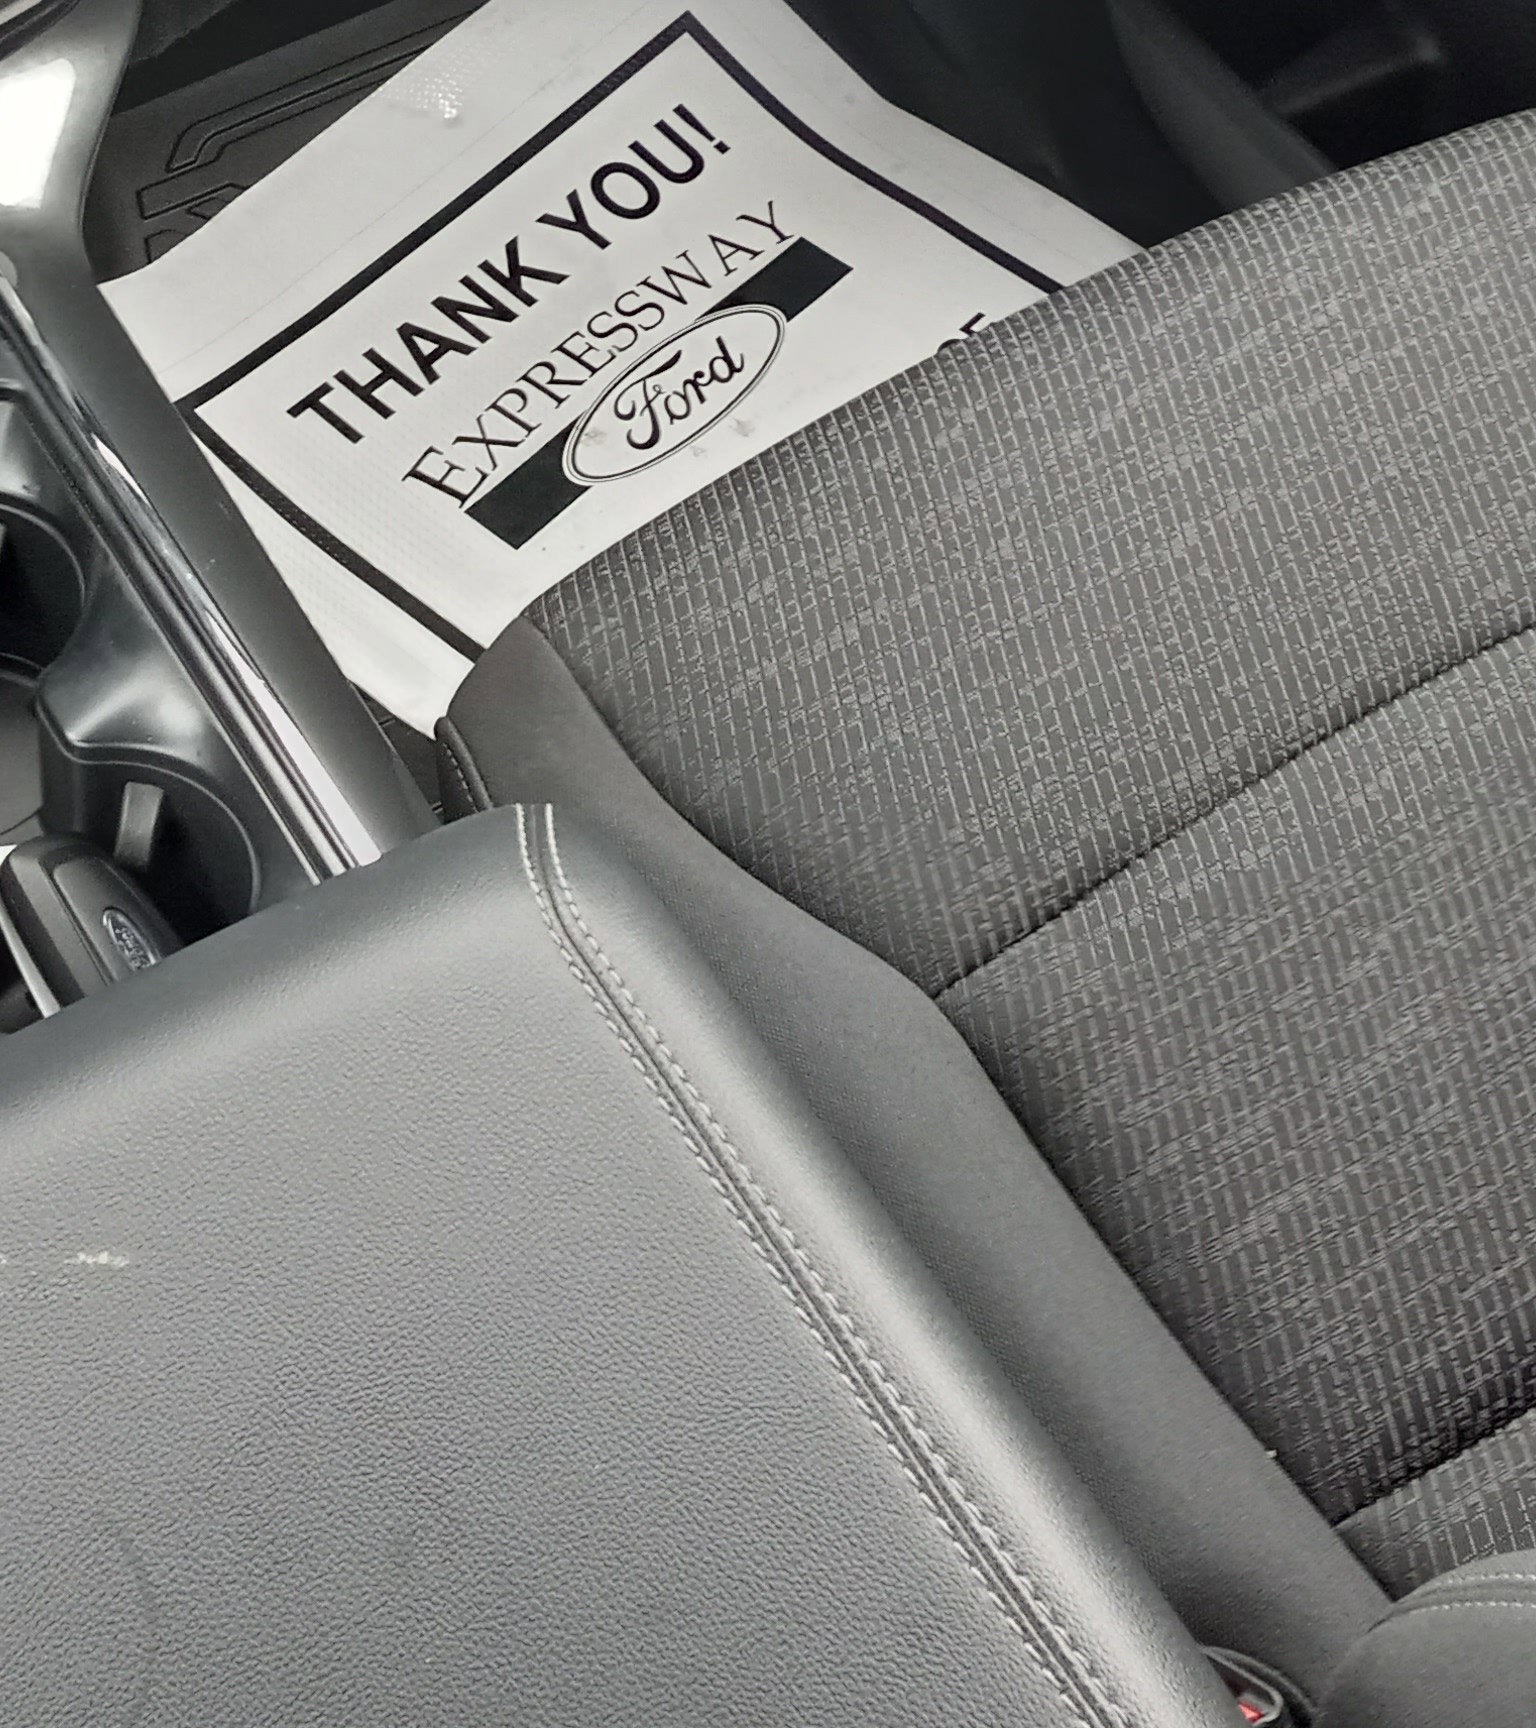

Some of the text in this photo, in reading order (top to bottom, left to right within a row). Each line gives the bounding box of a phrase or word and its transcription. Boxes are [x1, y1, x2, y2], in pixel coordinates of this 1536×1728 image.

[285, 102, 732, 445] THANK YOU!
[400, 199, 796, 509] EXPRESSWAY
[613, 335, 745, 452] Ford
